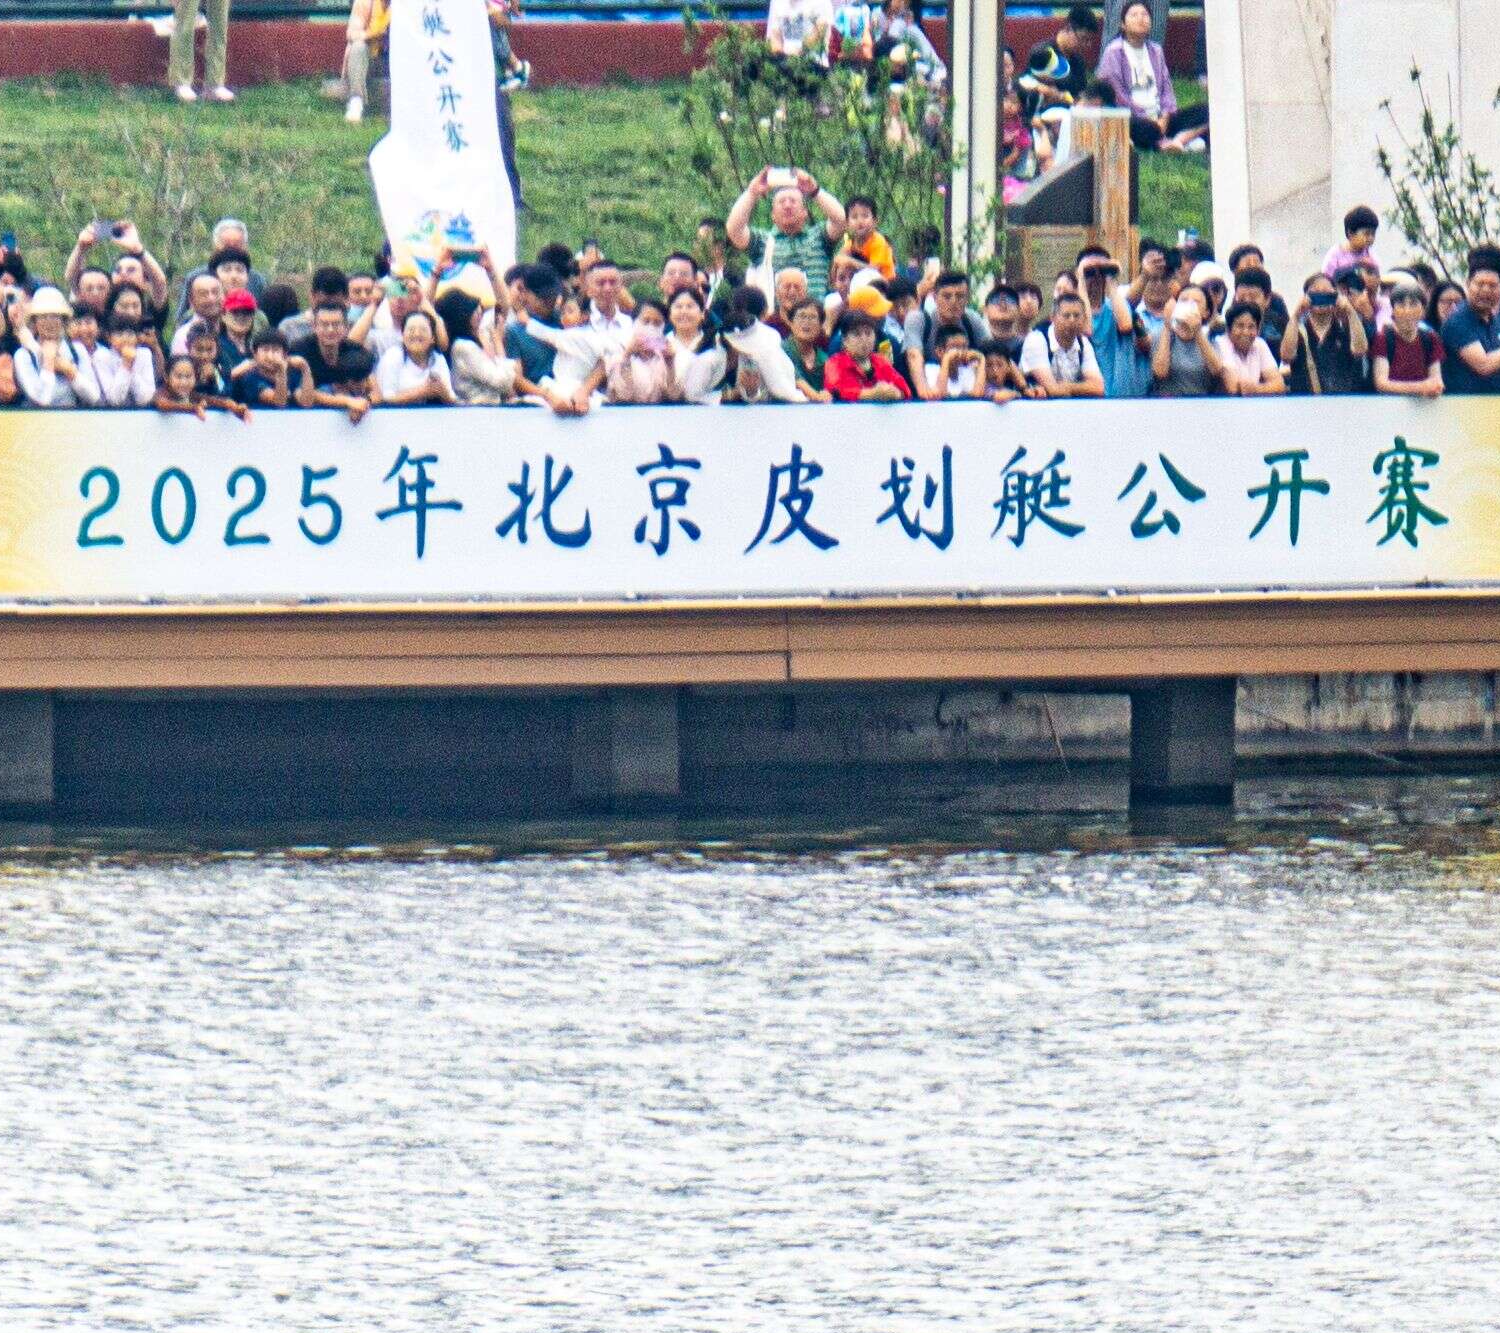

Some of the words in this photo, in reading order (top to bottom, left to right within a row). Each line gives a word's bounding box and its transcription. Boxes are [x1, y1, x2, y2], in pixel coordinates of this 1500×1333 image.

[77, 437, 1448, 558] 2025年北京皮划艇公开赛
